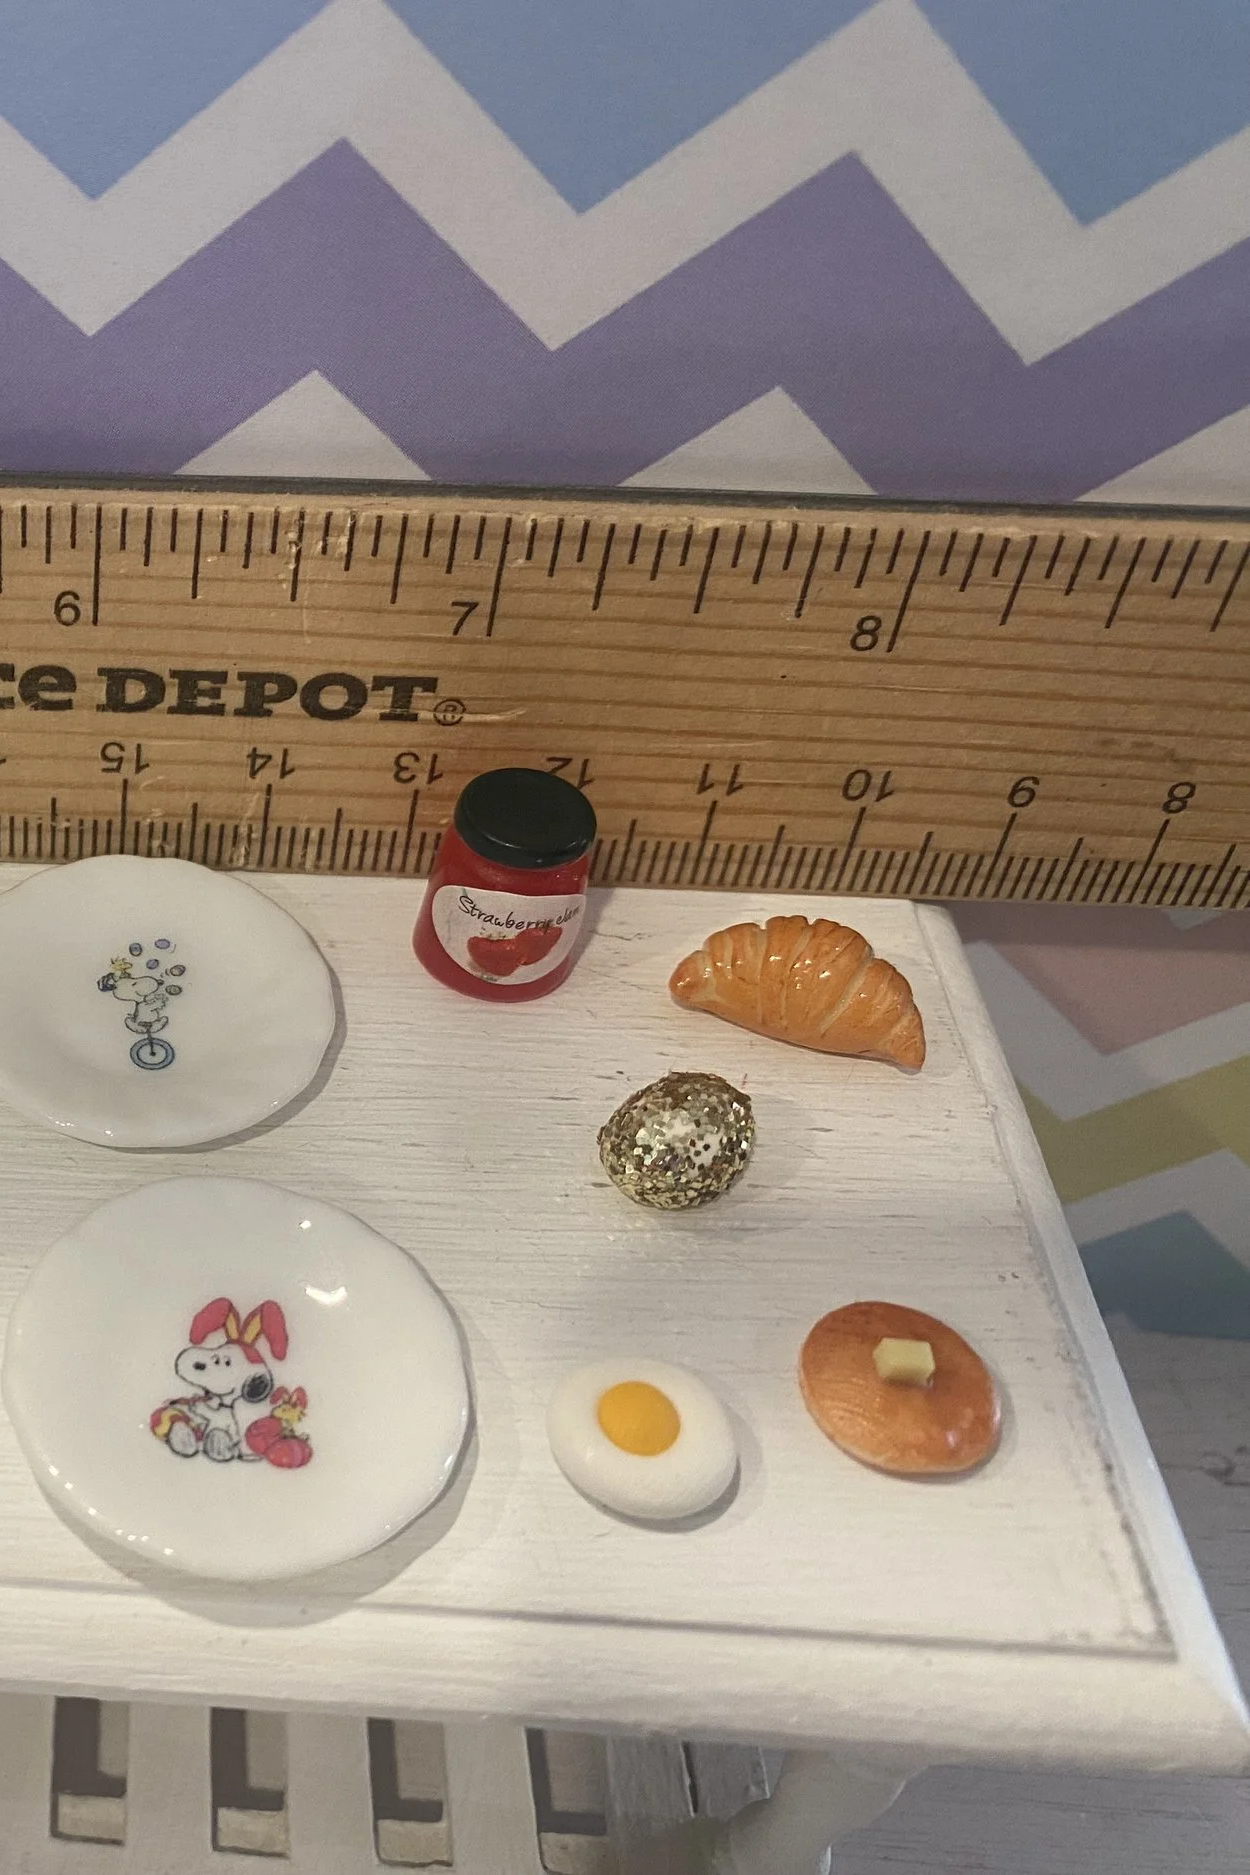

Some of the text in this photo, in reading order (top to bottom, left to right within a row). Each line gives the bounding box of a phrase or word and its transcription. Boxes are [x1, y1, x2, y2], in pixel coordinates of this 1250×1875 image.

[54, 591, 81, 626] 6
[450, 601, 478, 636] 7
[849, 615, 882, 652] 8
[100, 742, 150, 775] 15
[246, 747, 295, 780] 14
[392, 751, 444, 786] 13
[696, 763, 745, 797] 11
[841, 768, 896, 803] 10
[1007, 776, 1040, 808] 9
[1162, 781, 1197, 814] 8
